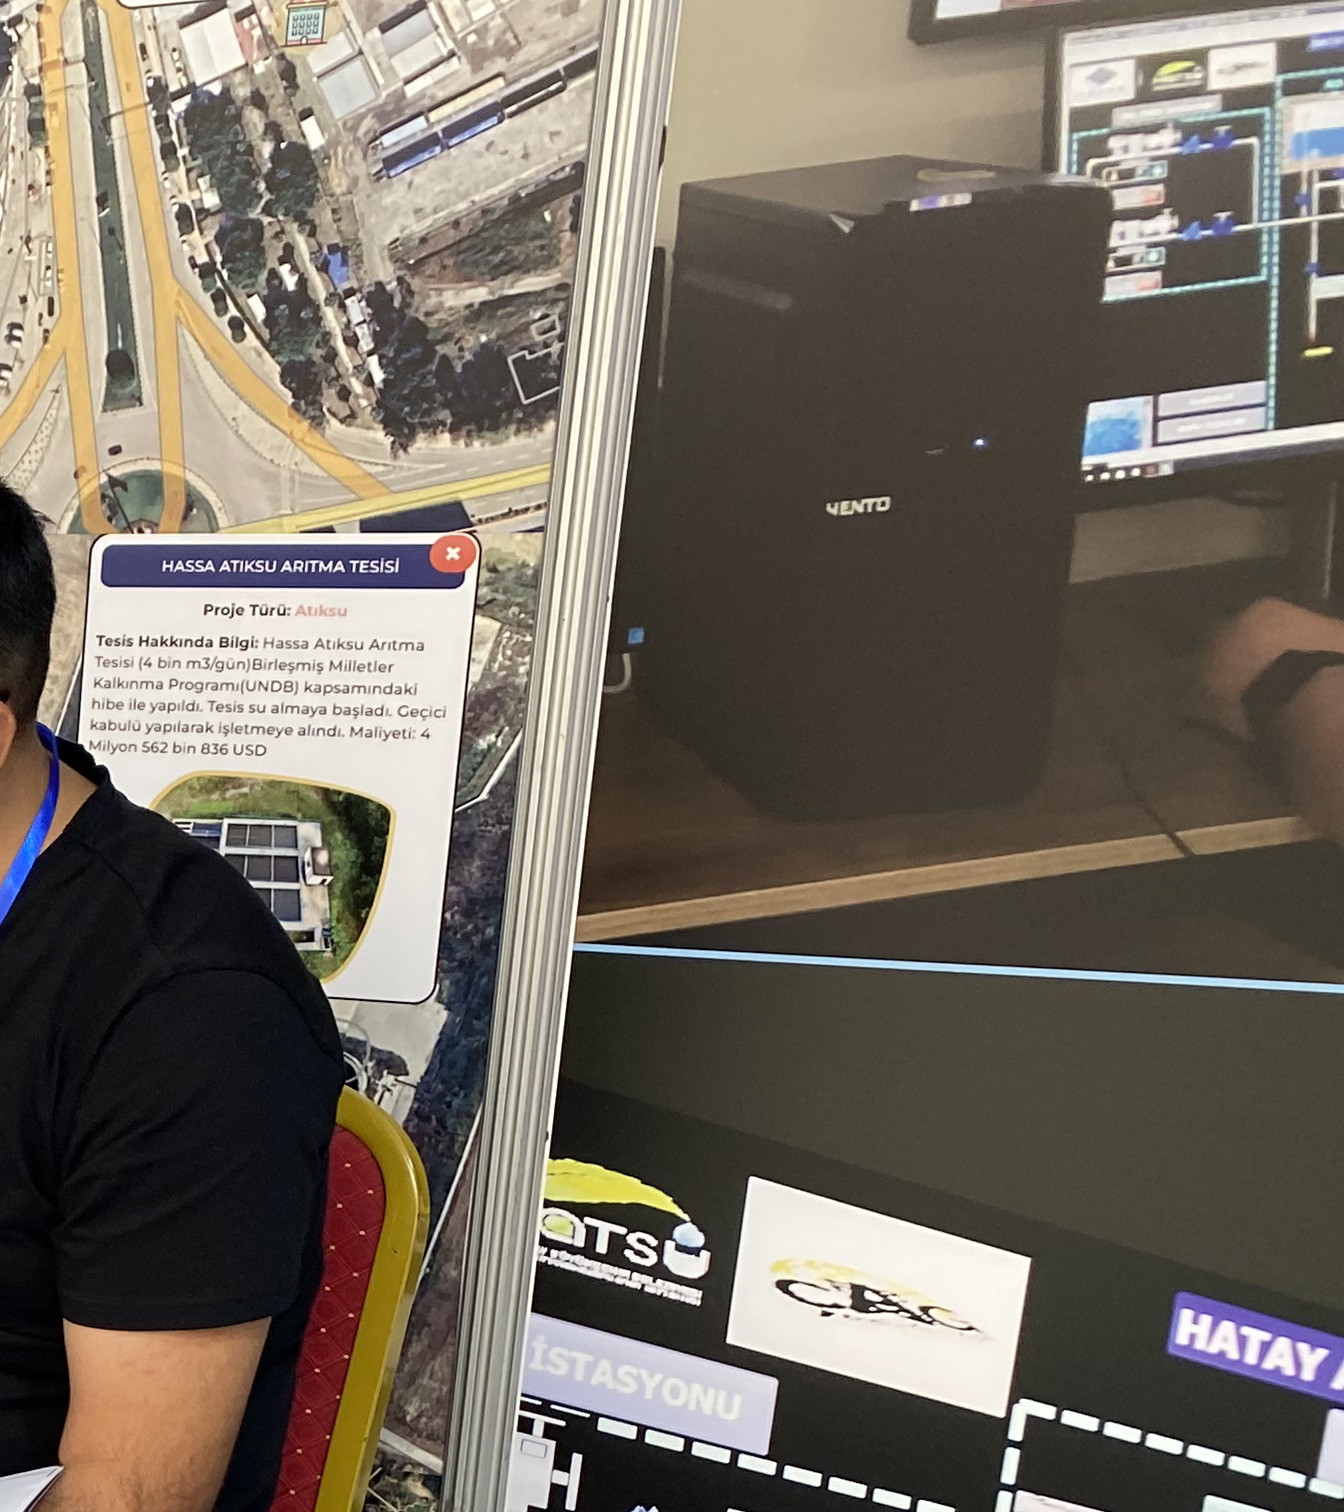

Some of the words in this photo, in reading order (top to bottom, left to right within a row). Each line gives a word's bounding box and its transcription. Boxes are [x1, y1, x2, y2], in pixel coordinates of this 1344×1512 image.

[826, 496, 892, 517] VENTO
[162, 559, 215, 573] HASSA
[219, 559, 277, 574] ATIKSU
[280, 559, 345, 574] ARITMA
[349, 557, 400, 574] TESİSİ
[203, 603, 244, 619] Proje
[249, 602, 291, 617] Türü:
[96, 634, 134, 648] Tesis
[138, 635, 213, 649] Hakkında
[219, 635, 259, 652] Bilgi:
[263, 637, 308, 650] Hassa
[313, 638, 364, 652] Atıksu
[368, 638, 425, 652] Arıtma
[94, 655, 135, 668] Tesisi
[138, 655, 153, 671] (4
[157, 656, 182, 669] bin
[329, 659, 394, 673] Milletler
[93, 677, 164, 691] Kalkınma
[304, 680, 418, 698] kapsamındaki
[91, 698, 124, 712] hibe
[128, 699, 145, 712] ile
[149, 700, 203, 717] yapıldı.
[208, 701, 244, 714] Tesis
[248, 704, 266, 714] su
[270, 702, 328, 719] almaya
[332, 704, 392, 721] başladı.
[397, 705, 447, 722] Geçici
[90, 720, 141, 734] kabulü
[145, 720, 214, 738] yapılarak
[218, 722, 293, 739] işletmeye
[297, 724, 345, 738] alındı.
[350, 725, 416, 742] Maliyeti:
[420, 727, 431, 740] 4
[88, 739, 137, 757] Milyon
[141, 741, 168, 755] 562
[172, 741, 197, 755] bin
[201, 742, 229, 757] 836
[232, 743, 267, 757] USD
[1174, 1308, 1331, 1382] HATAY
[530, 1336, 744, 1424] İSTASYONU
